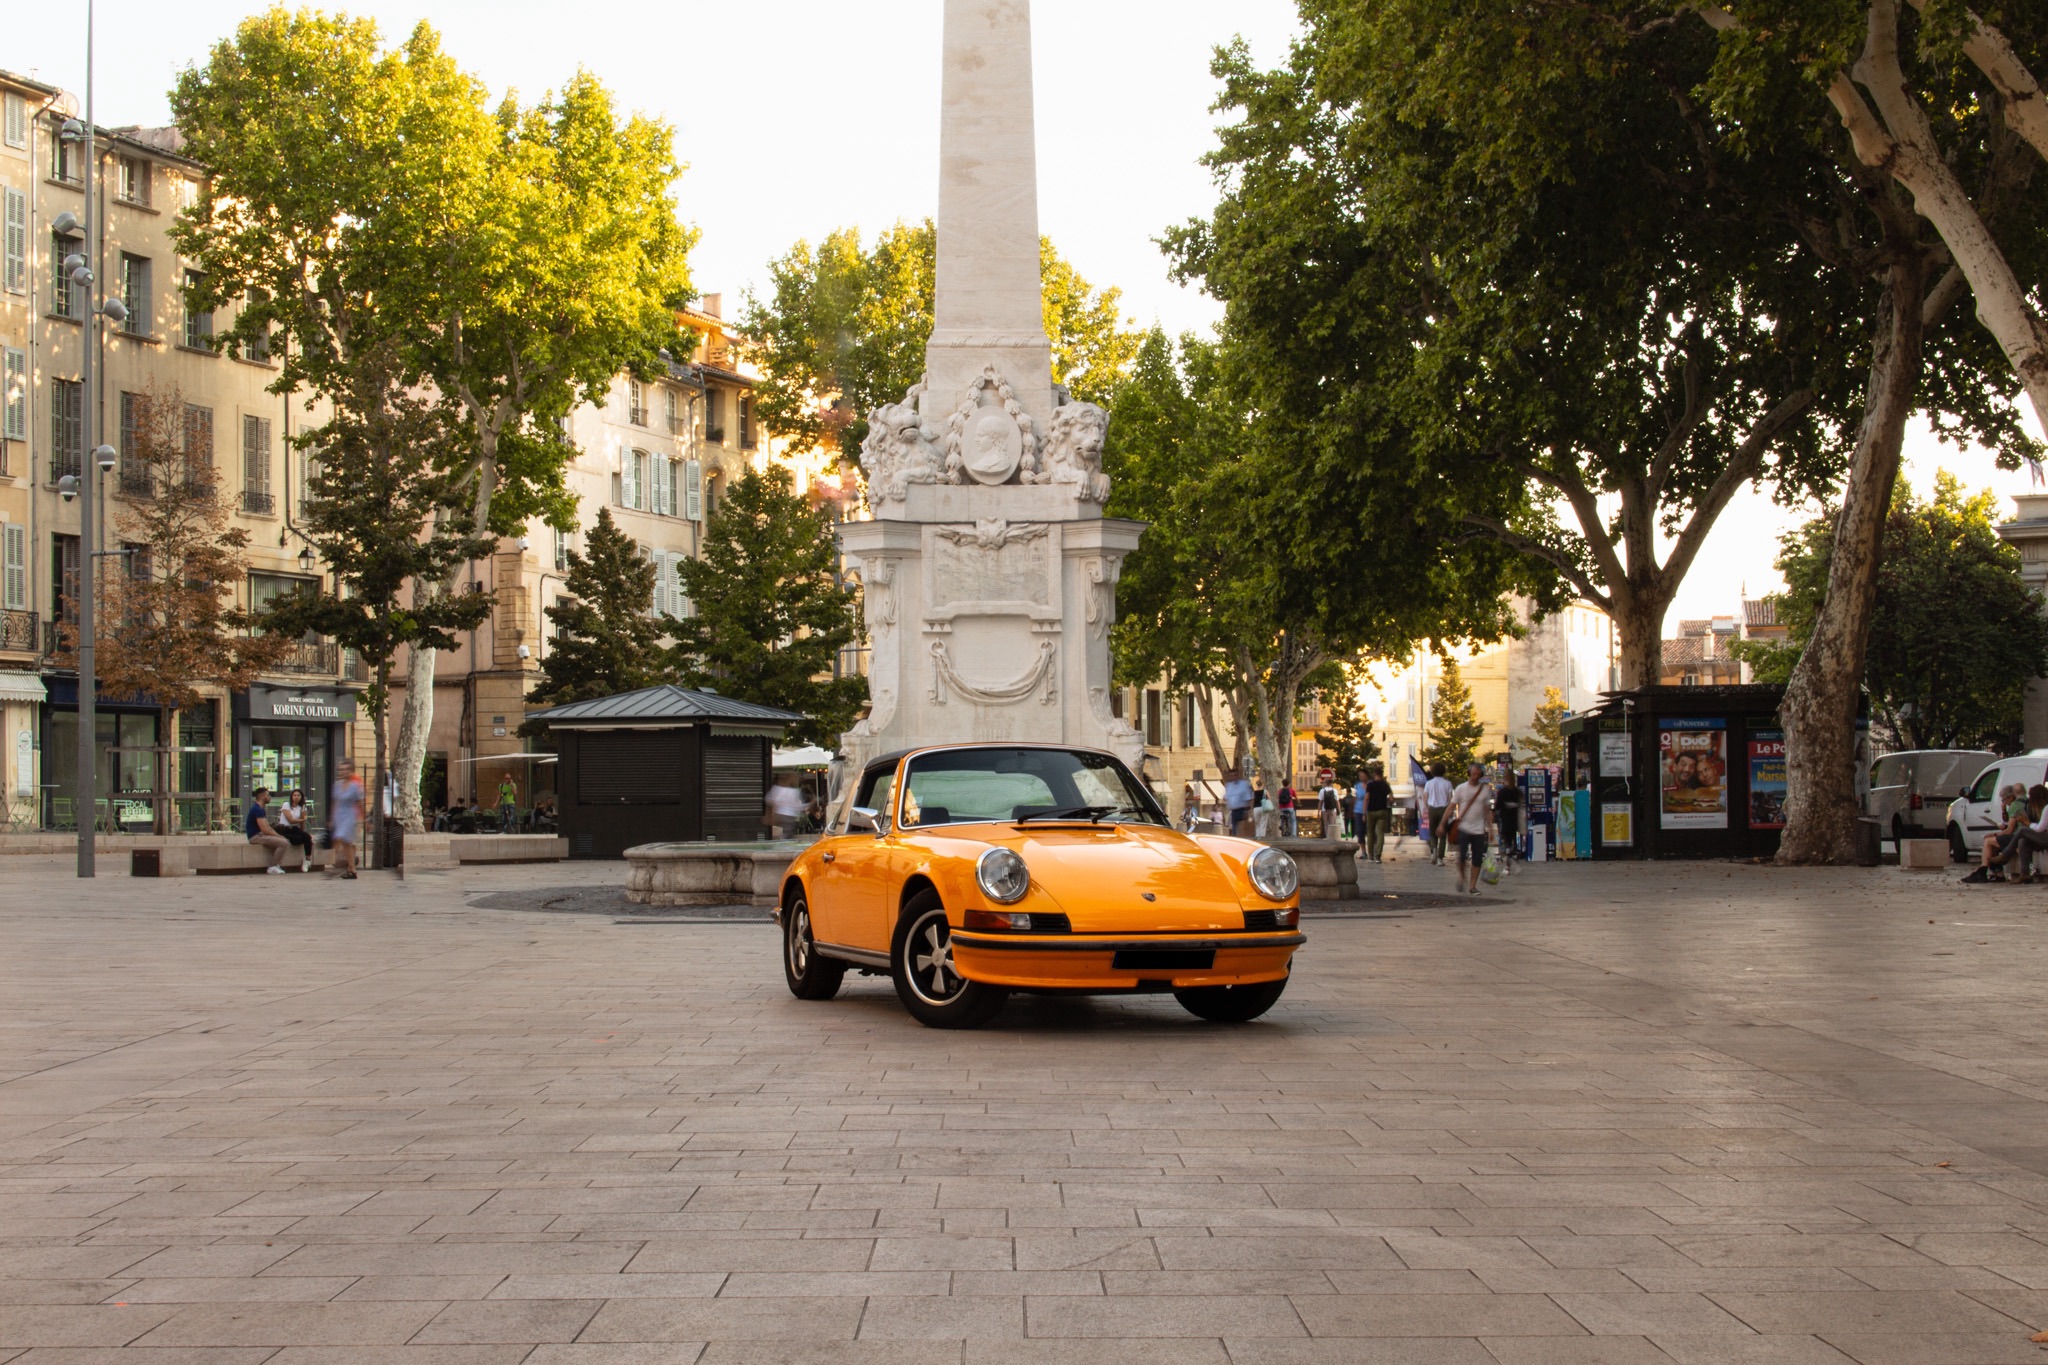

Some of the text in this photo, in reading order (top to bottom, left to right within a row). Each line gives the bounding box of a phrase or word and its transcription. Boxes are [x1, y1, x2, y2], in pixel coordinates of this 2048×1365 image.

[273, 704, 305, 715] KORINE
[305, 705, 339, 717] OLIVIER
[1757, 744, 1786, 753] Le Po
